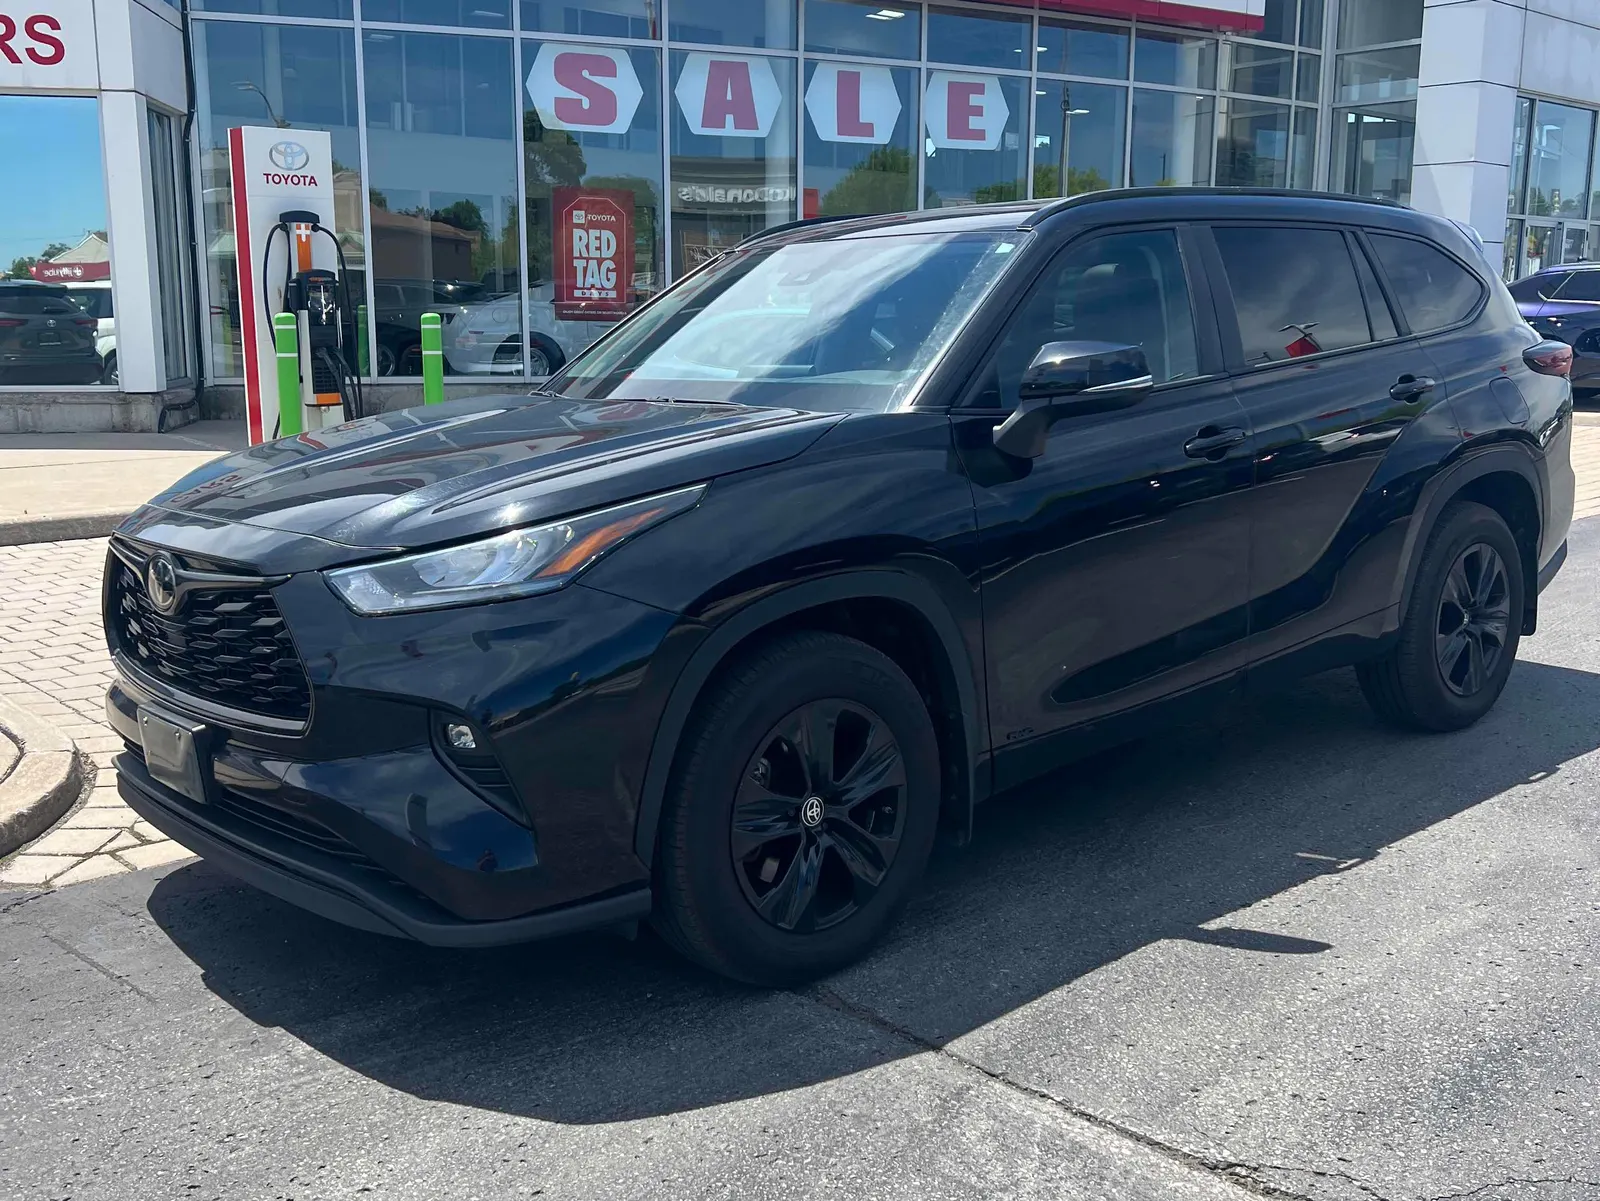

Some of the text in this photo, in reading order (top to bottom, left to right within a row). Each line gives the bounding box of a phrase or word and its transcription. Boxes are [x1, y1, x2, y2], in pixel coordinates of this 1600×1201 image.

[263, 173, 318, 187] TOYOTA
[587, 214, 616, 222] TOYOTA
[573, 228, 617, 258] RED
[573, 259, 617, 289] TAG
